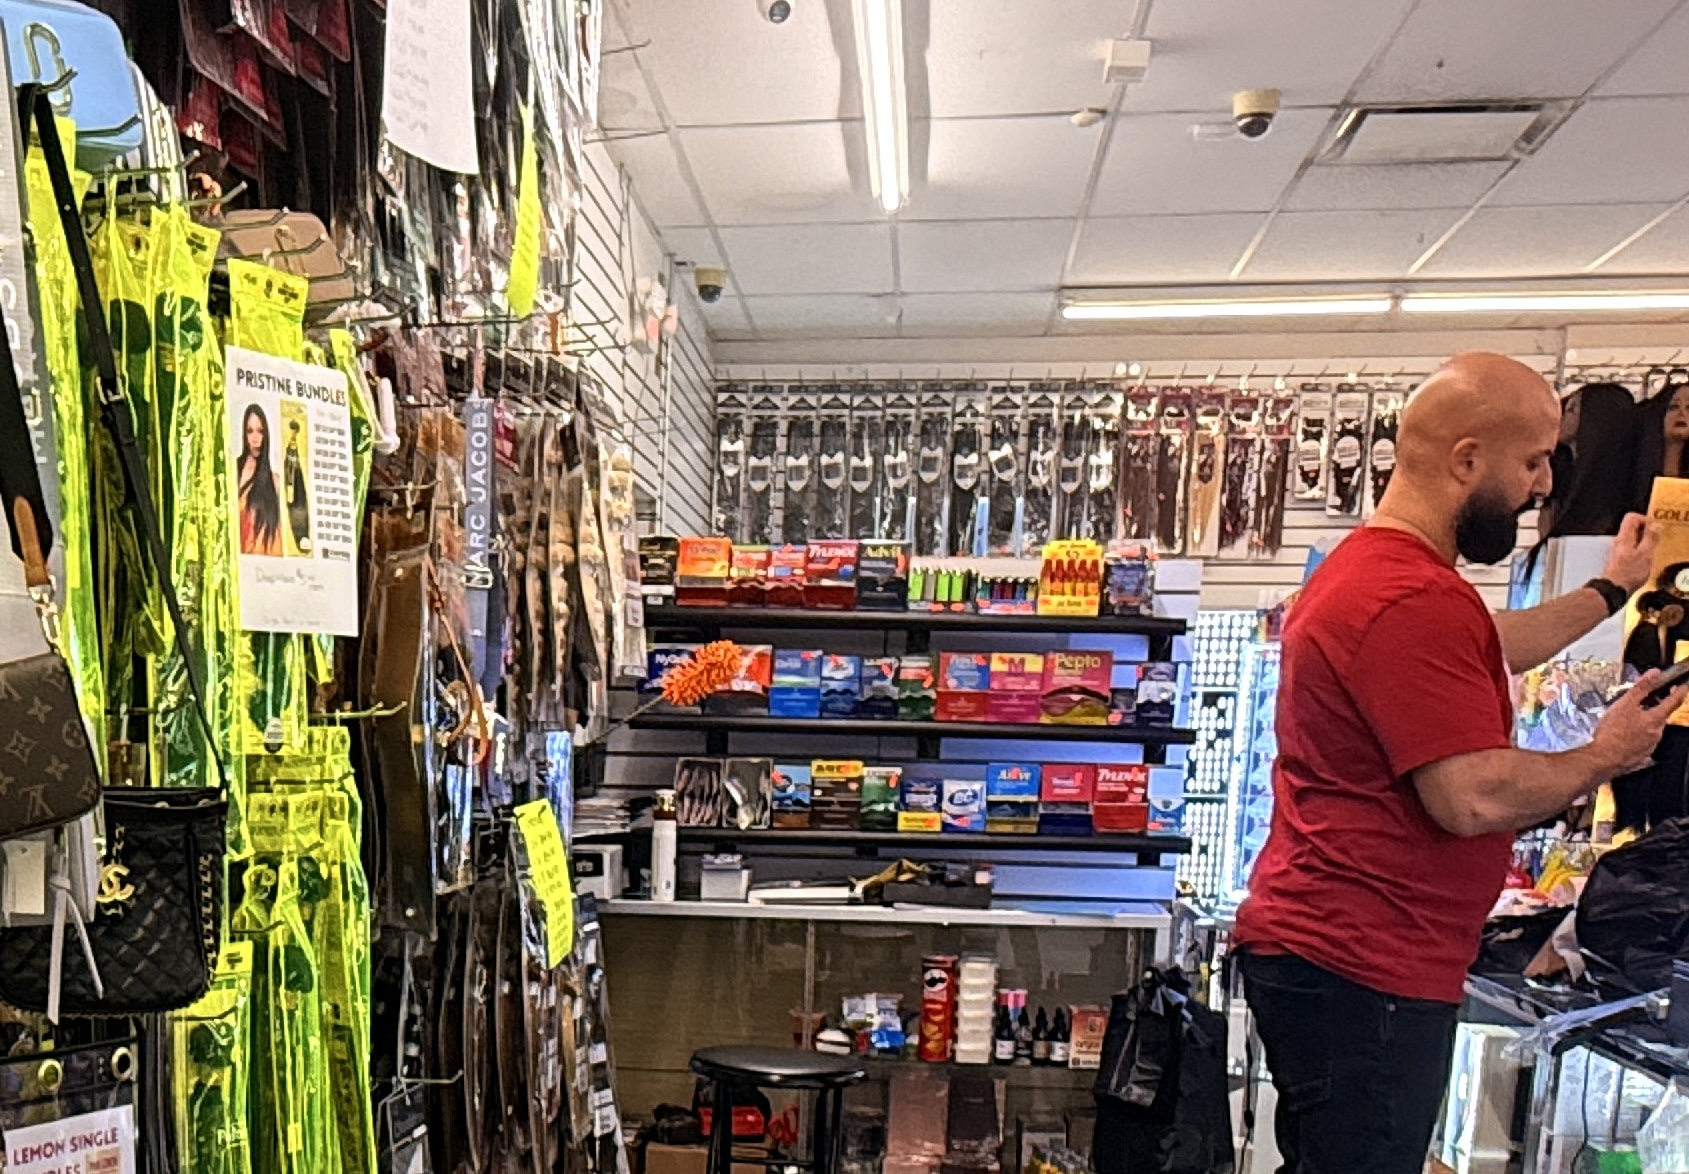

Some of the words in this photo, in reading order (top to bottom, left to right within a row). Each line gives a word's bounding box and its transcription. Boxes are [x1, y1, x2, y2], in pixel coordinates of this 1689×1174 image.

[236, 367, 292, 396] PRISTINE
[295, 380, 347, 407] BUNDLES
[1055, 652, 1102, 670] Pepto
[1097, 768, 1146, 782] TYLENL
[13, 1141, 65, 1166] LEMON
[69, 1126, 119, 1153] SINGLE
